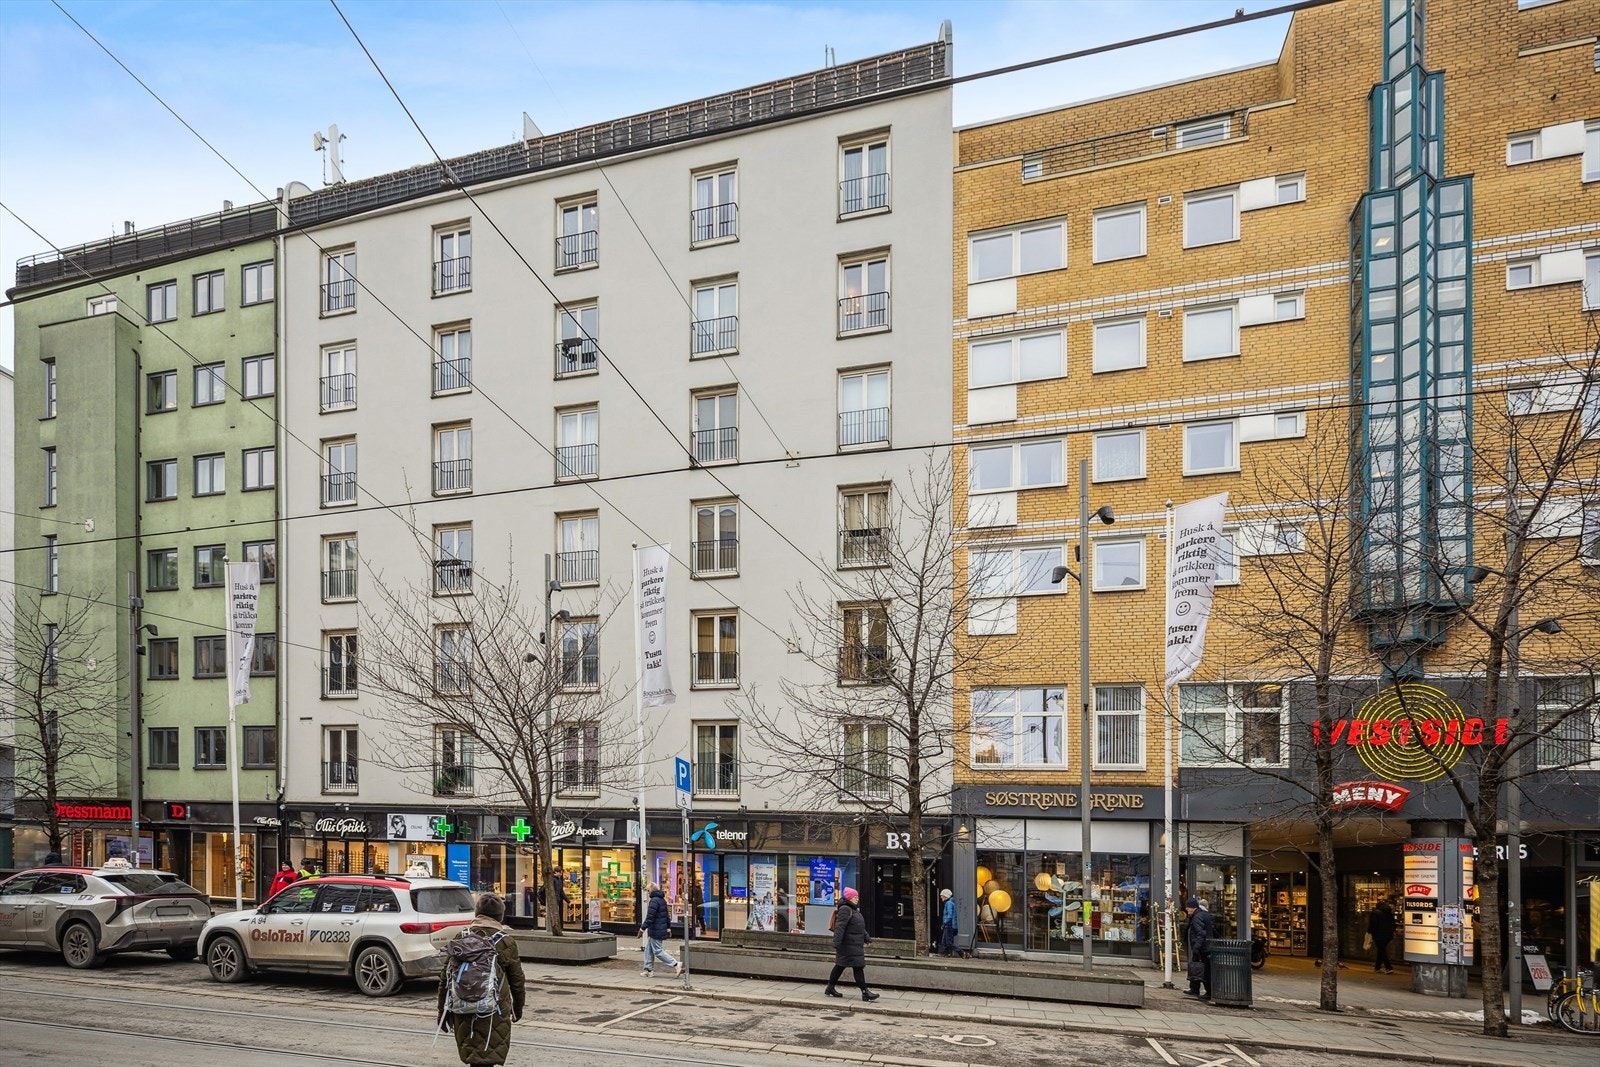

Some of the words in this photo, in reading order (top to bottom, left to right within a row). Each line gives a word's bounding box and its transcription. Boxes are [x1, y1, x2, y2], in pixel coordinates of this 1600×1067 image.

[1180, 523, 1205, 539] Husk
[1206, 521, 1213, 531] å
[1175, 536, 1215, 554] parkere
[1178, 547, 1207, 562] riktig
[1178, 560, 1215, 574] trikken
[641, 576, 665, 590] parkere
[643, 586, 661, 598] riktig
[1174, 588, 1198, 599] frem
[645, 649, 662, 660] Tusen
[646, 659, 662, 670] takk!
[678, 762, 688, 786] P
[985, 791, 1078, 810] SØSTRENE
[1332, 786, 1402, 805] MENY
[171, 804, 185, 818] D
[315, 817, 336, 833] Ollis
[336, 817, 368, 837] Optikk
[576, 827, 605, 837] Apotek
[716, 830, 748, 840] telenor
[251, 917, 257, 925] A
[258, 917, 267, 925] 94
[251, 928, 305, 942] OsloTaxi
[320, 930, 350, 942] 02323
